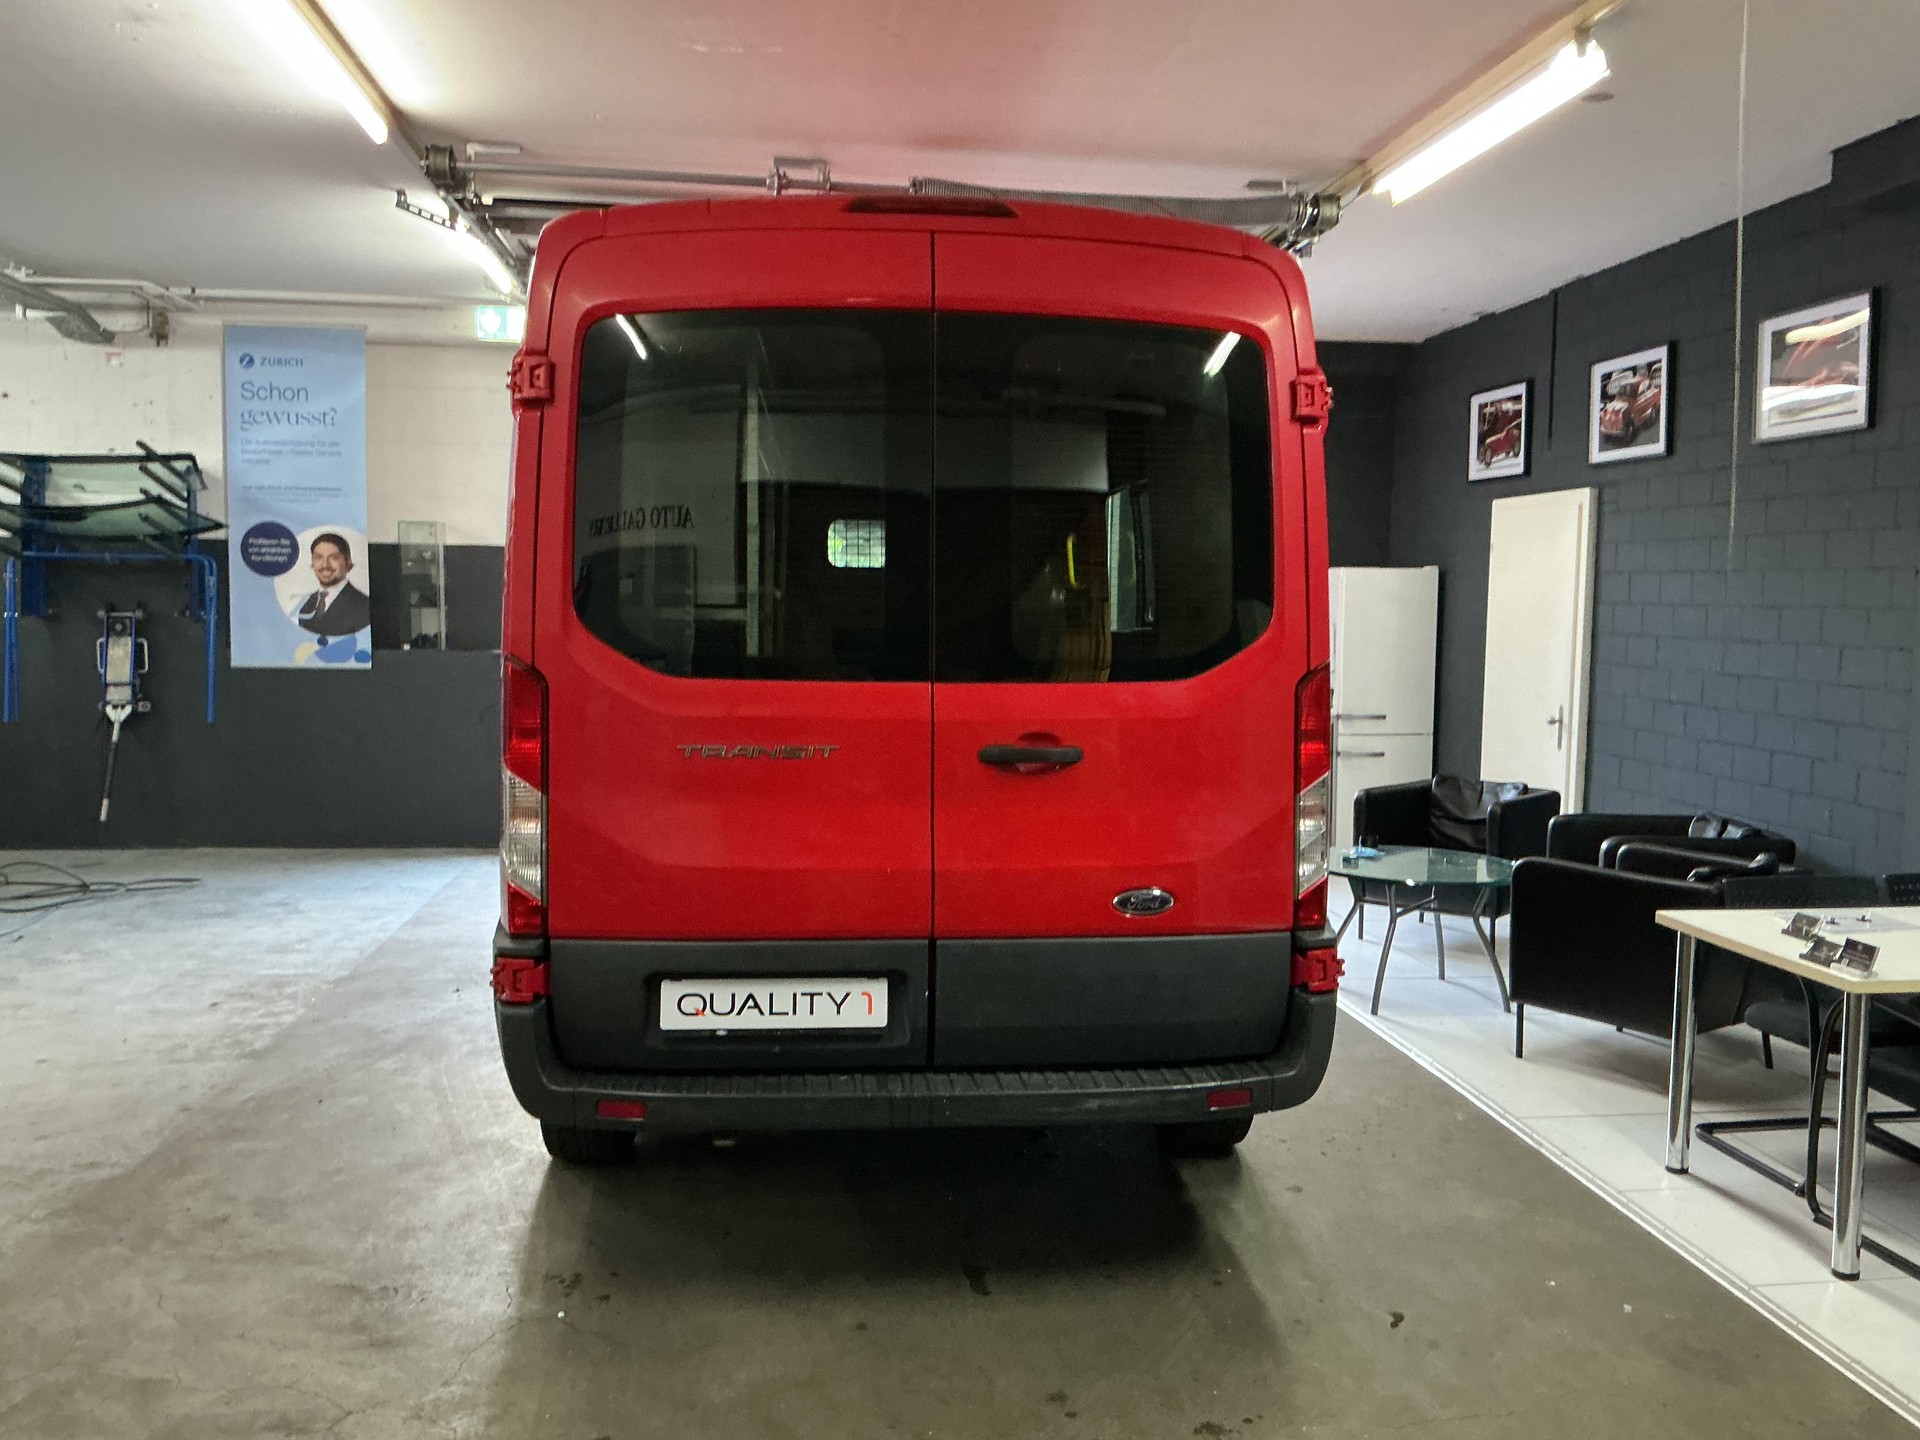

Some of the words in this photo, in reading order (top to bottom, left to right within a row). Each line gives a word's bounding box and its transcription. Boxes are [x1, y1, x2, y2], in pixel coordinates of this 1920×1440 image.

[260, 357, 304, 367] ZURICH
[240, 381, 309, 401] Schon
[240, 407, 338, 431] gewusst?
[677, 744, 840, 759] TRANSIT
[1127, 895, 1162, 910] Ford
[676, 992, 852, 1017] QUALITY
[861, 991, 873, 1015] 1
